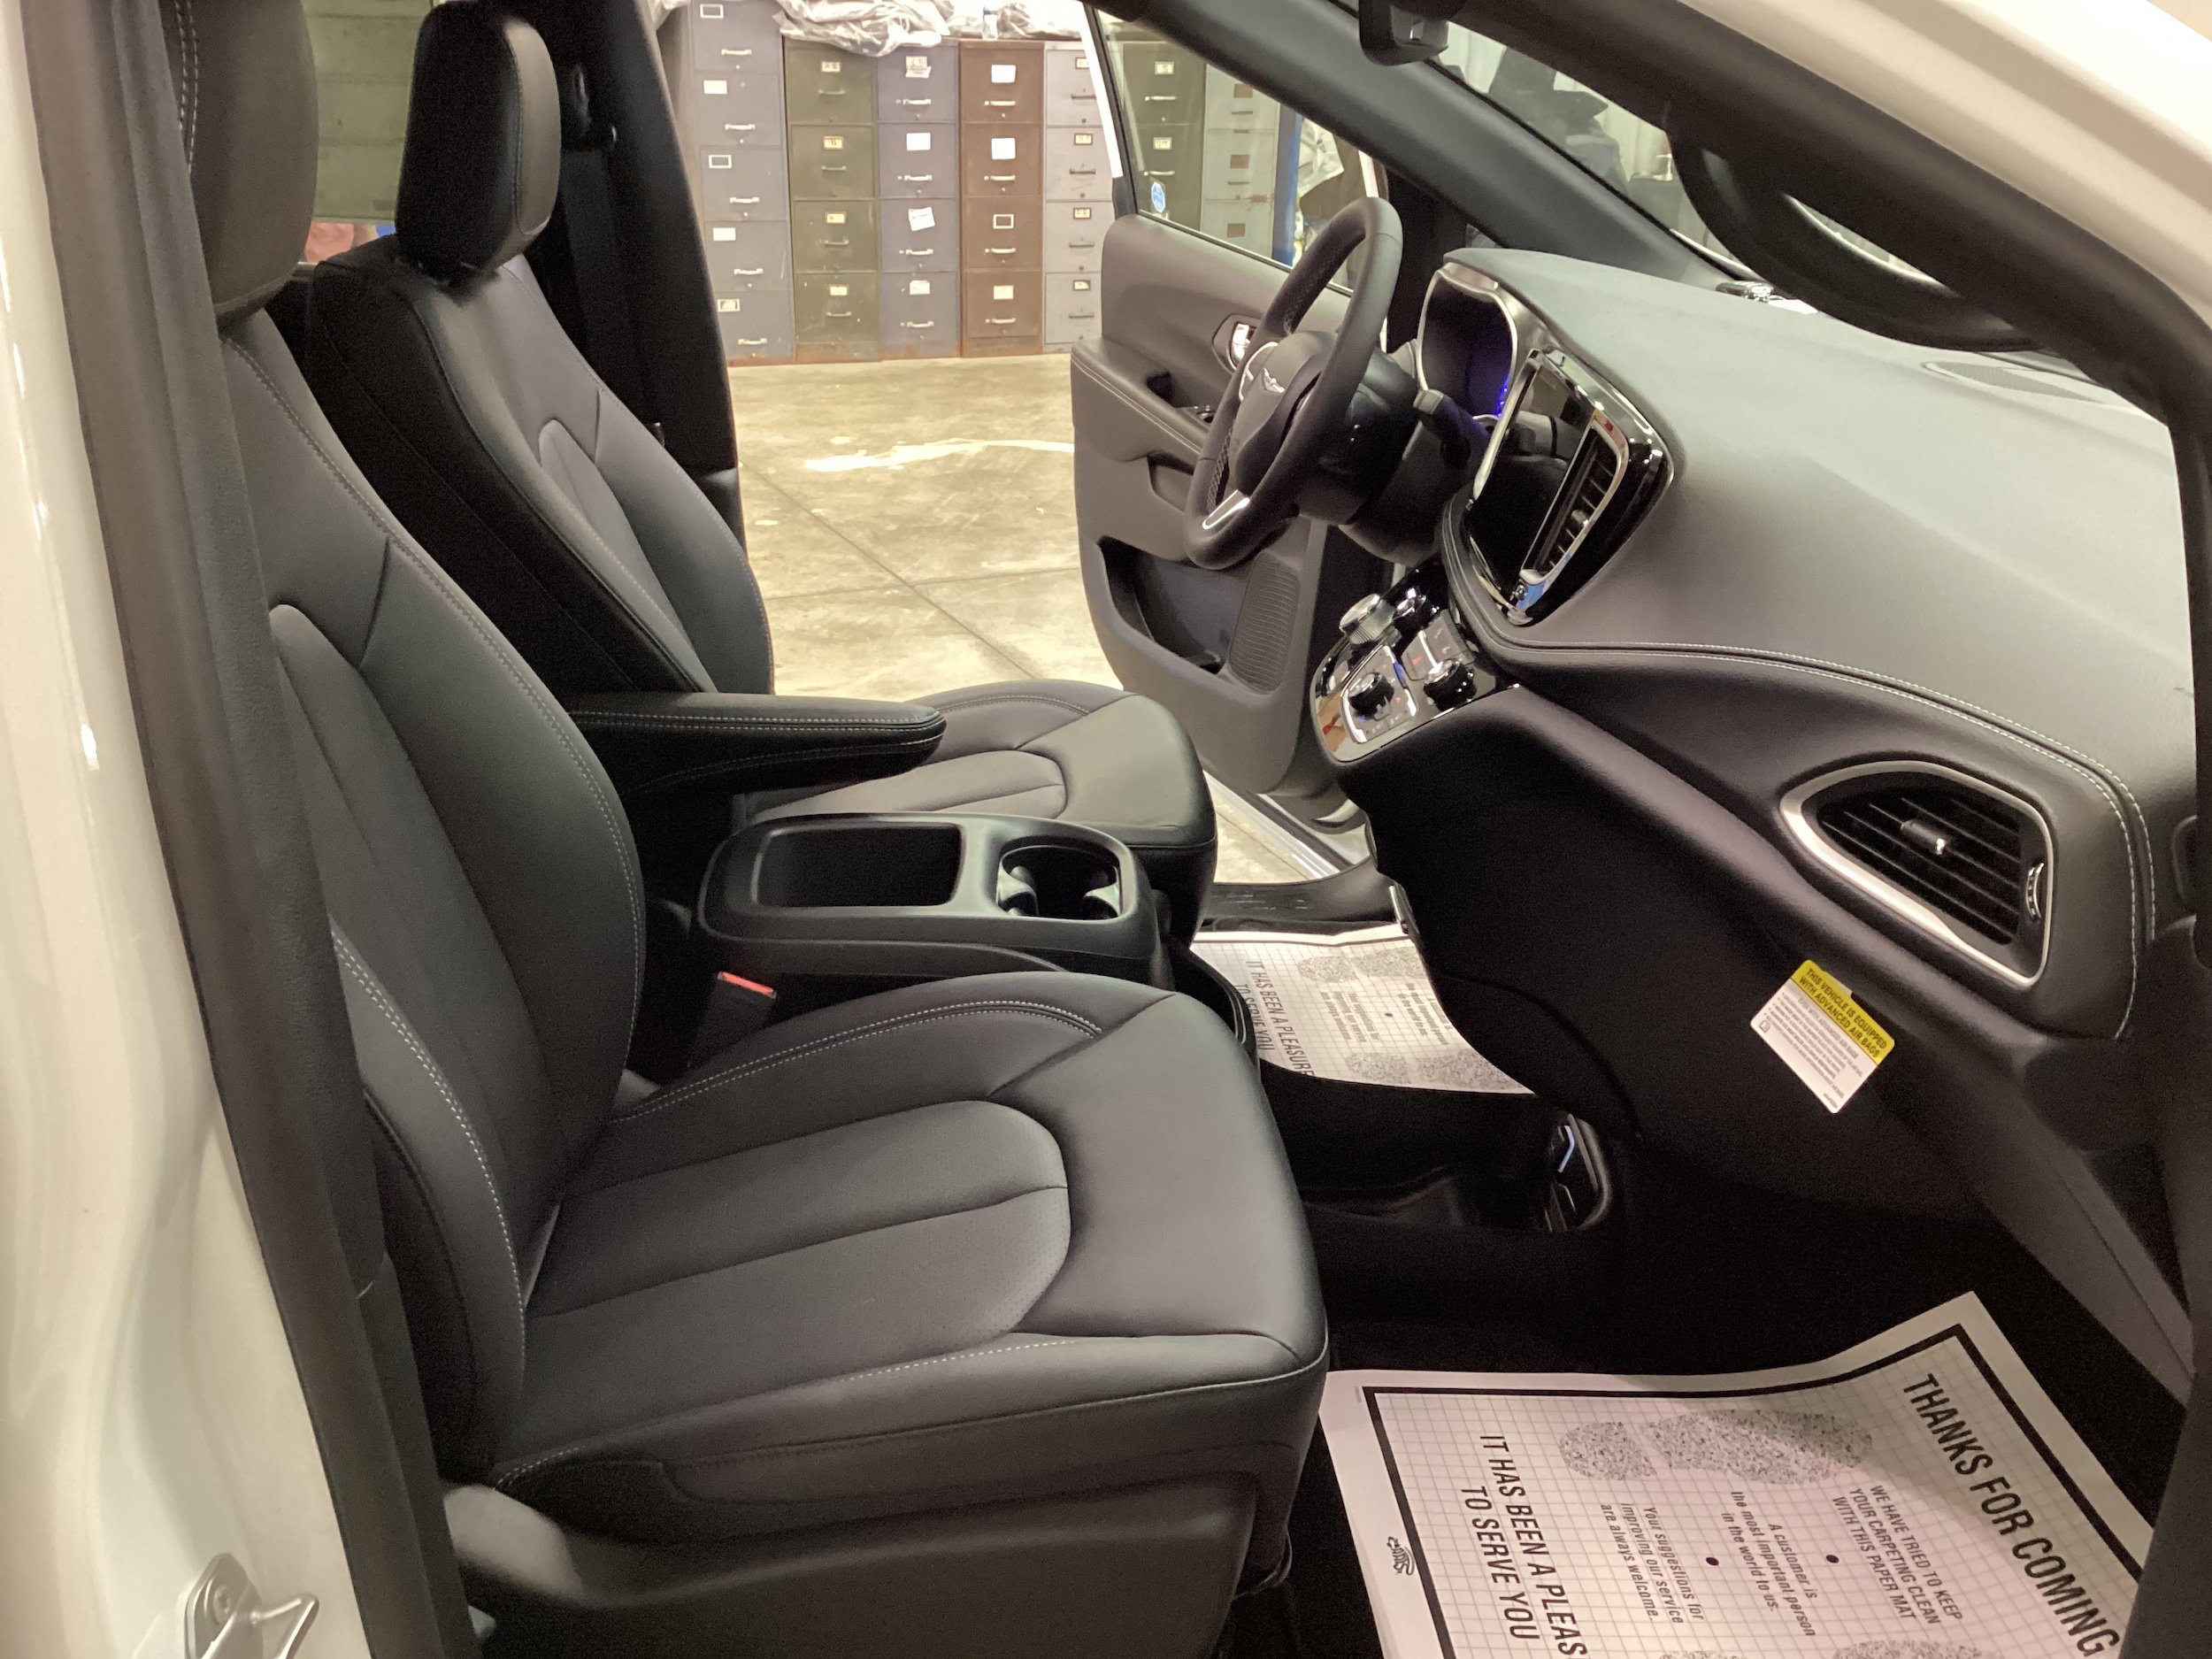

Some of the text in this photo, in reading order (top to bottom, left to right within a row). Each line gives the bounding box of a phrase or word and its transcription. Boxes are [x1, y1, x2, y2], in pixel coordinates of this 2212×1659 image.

[1250, 972, 1273, 988] HAS
[1260, 991, 1286, 1014] BEEN
[1799, 976, 1880, 1058] WITH ADVANCED AIR BAGS
[1806, 968, 1887, 1049] THIS VEHICLE IS EQUIPPED
[1255, 1030, 1275, 1050] YOU
[1461, 1486, 1540, 1640] TO SERVE YOU
[1479, 1436, 1588, 1659] IT HAS BEEN A PLEAS
[1601, 1504, 1659, 1621] are always welcome.
[1620, 1503, 1684, 1624] improving our service
[1643, 1507, 1704, 1620] Your suggestions for
[1721, 1513, 1779, 1612] in the world to us.
[1731, 1491, 1816, 1636] the most important person
[1774, 1533, 1810, 1586] customer
[1803, 1588, 1818, 1599] is
[1832, 1496, 1916, 1619] WITH THIS PAPER MAT
[1849, 1488, 1941, 1624] YOUR CARPETING CLEAN
[1870, 1485, 1963, 1620] WE HAVE TRIED TO KEEP
[1903, 1373, 2120, 1657] THANKS FOR COMING
